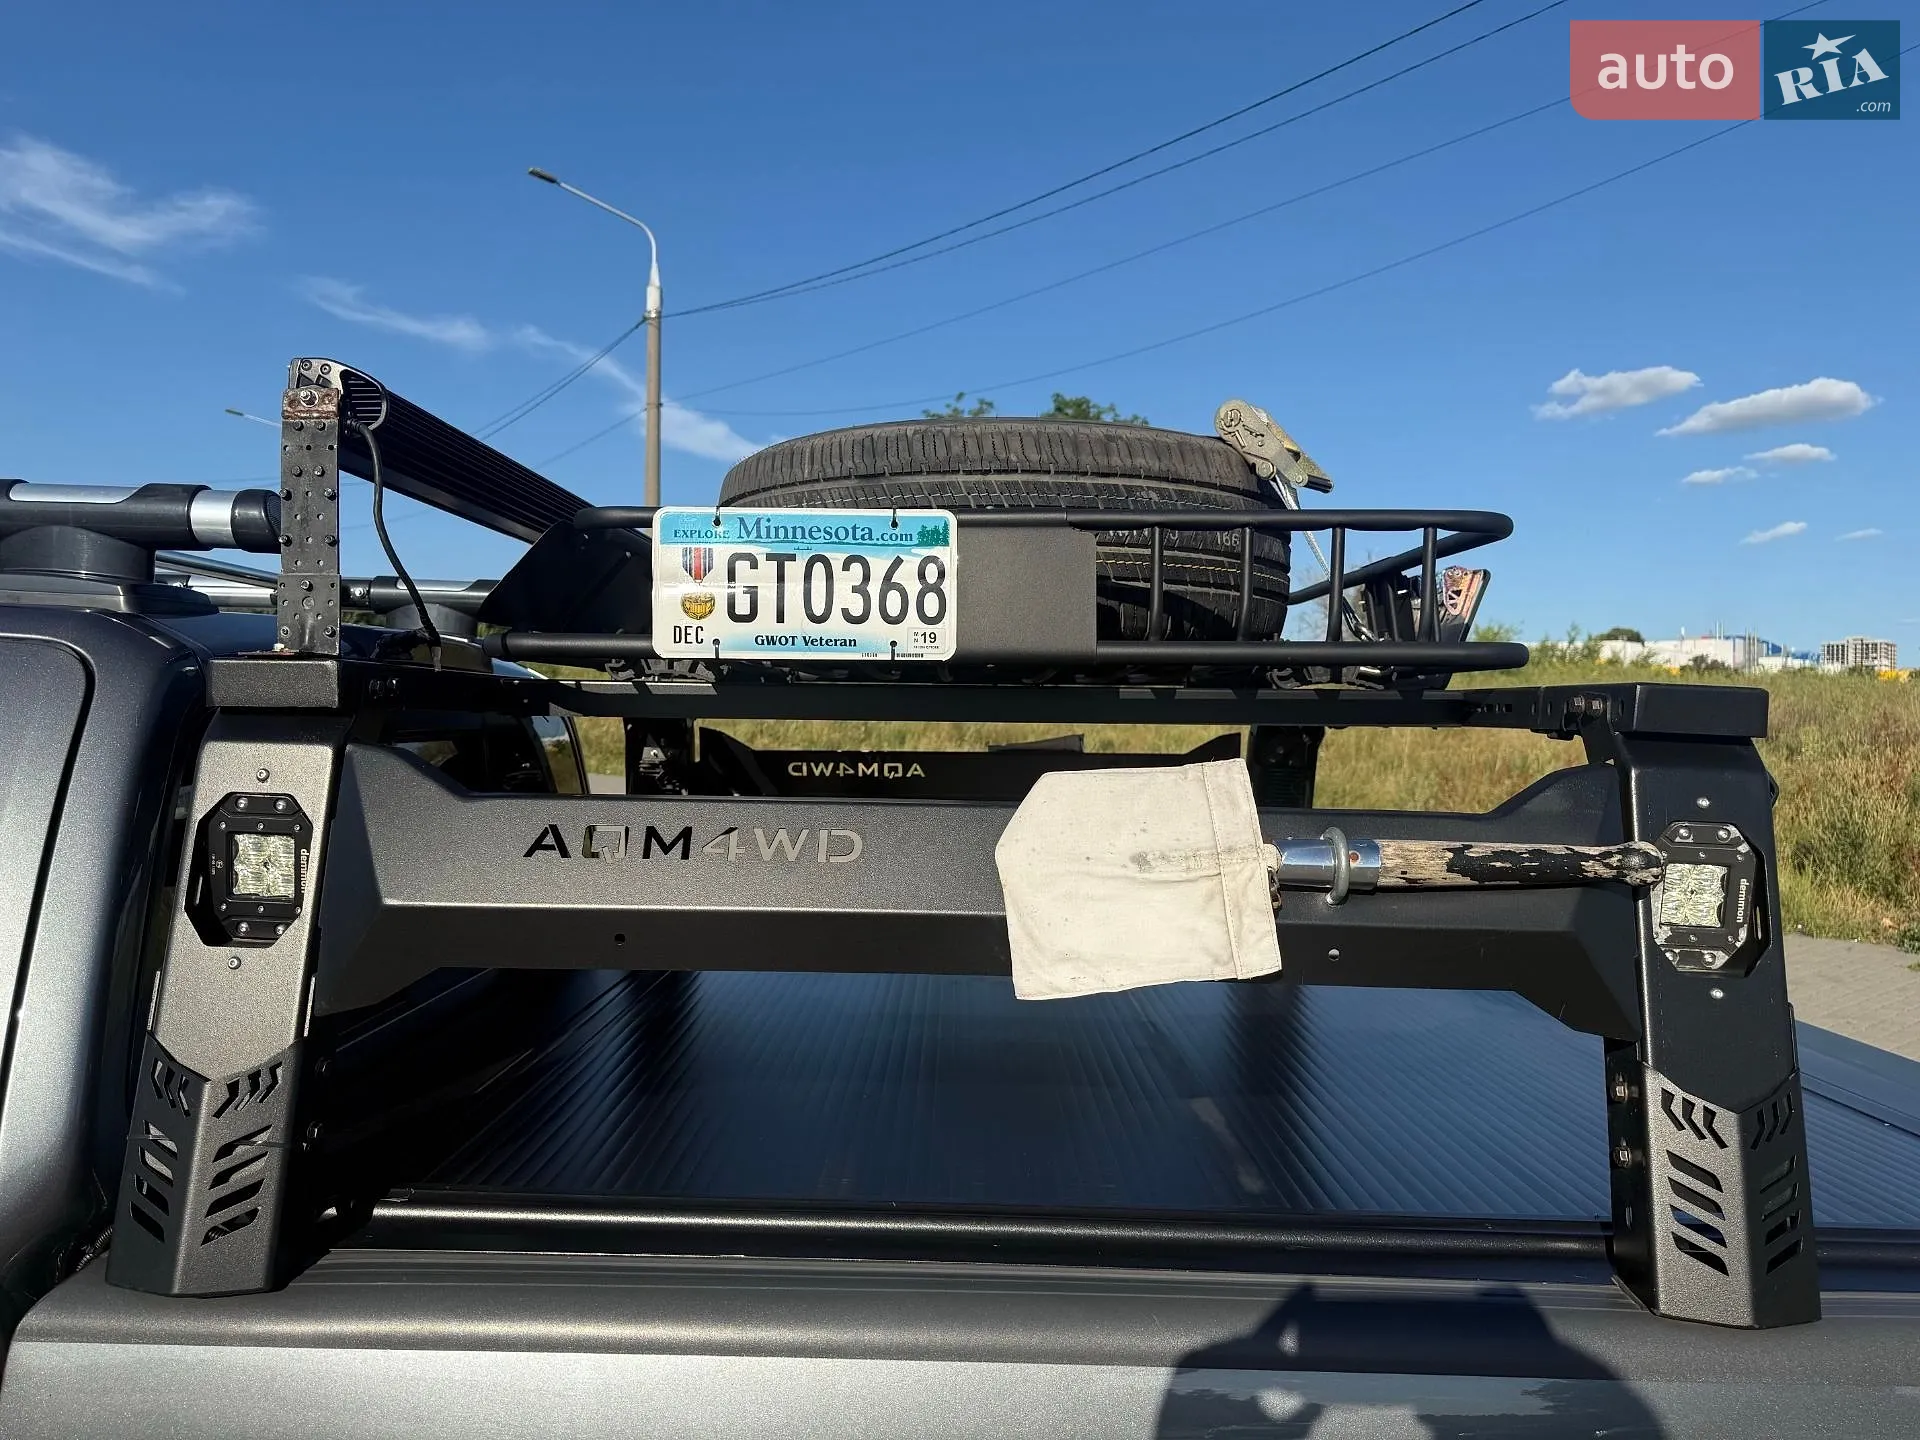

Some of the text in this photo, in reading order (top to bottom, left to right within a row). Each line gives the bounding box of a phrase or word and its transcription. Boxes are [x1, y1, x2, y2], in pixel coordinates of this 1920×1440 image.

[673, 516, 913, 543] EXPLORE Minnesota.com
[727, 551, 947, 626] GT0368
[673, 625, 705, 645] DEC
[754, 634, 858, 648] GWOT Veteran
[920, 631, 937, 644] 19
[522, 823, 865, 864] AQM4WD
[1736, 878, 1750, 923] demmon
